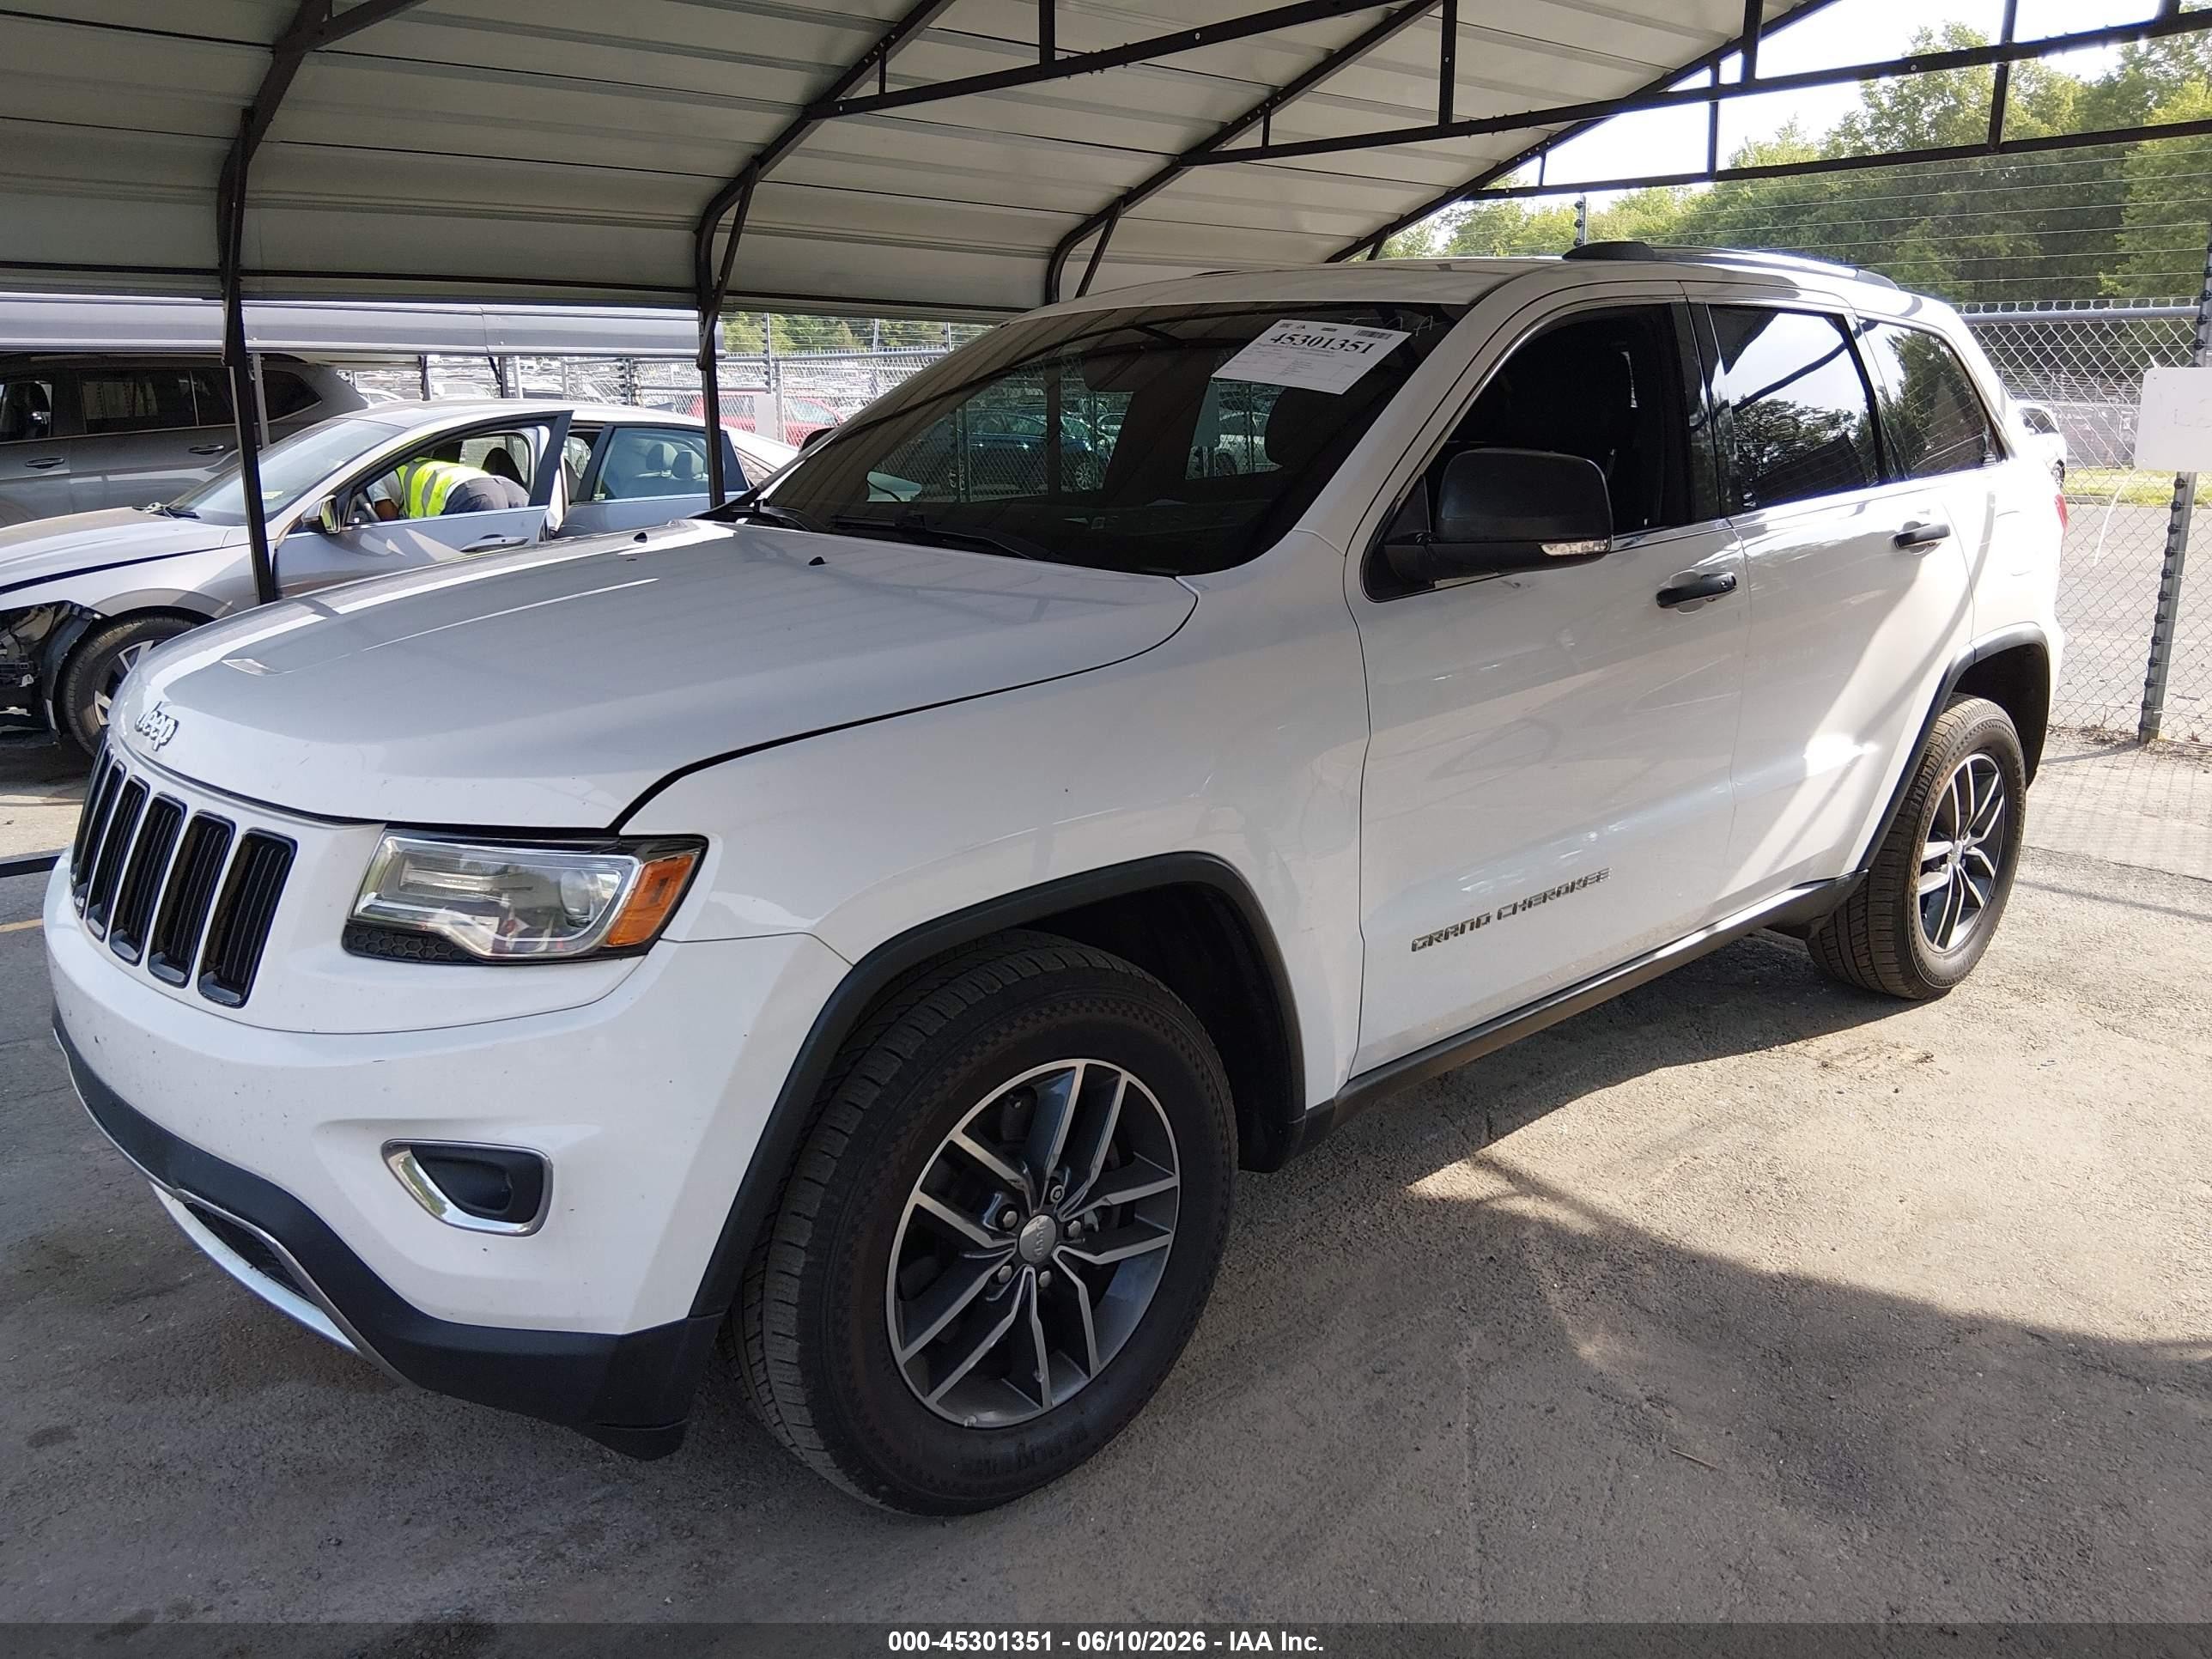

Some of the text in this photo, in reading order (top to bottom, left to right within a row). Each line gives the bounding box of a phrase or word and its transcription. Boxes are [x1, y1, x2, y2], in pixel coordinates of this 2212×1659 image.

[1270, 332, 1375, 354] 45301351
[134, 701, 179, 751] Jeep
[1411, 866, 1613, 952] GRAND CHEROKEE
